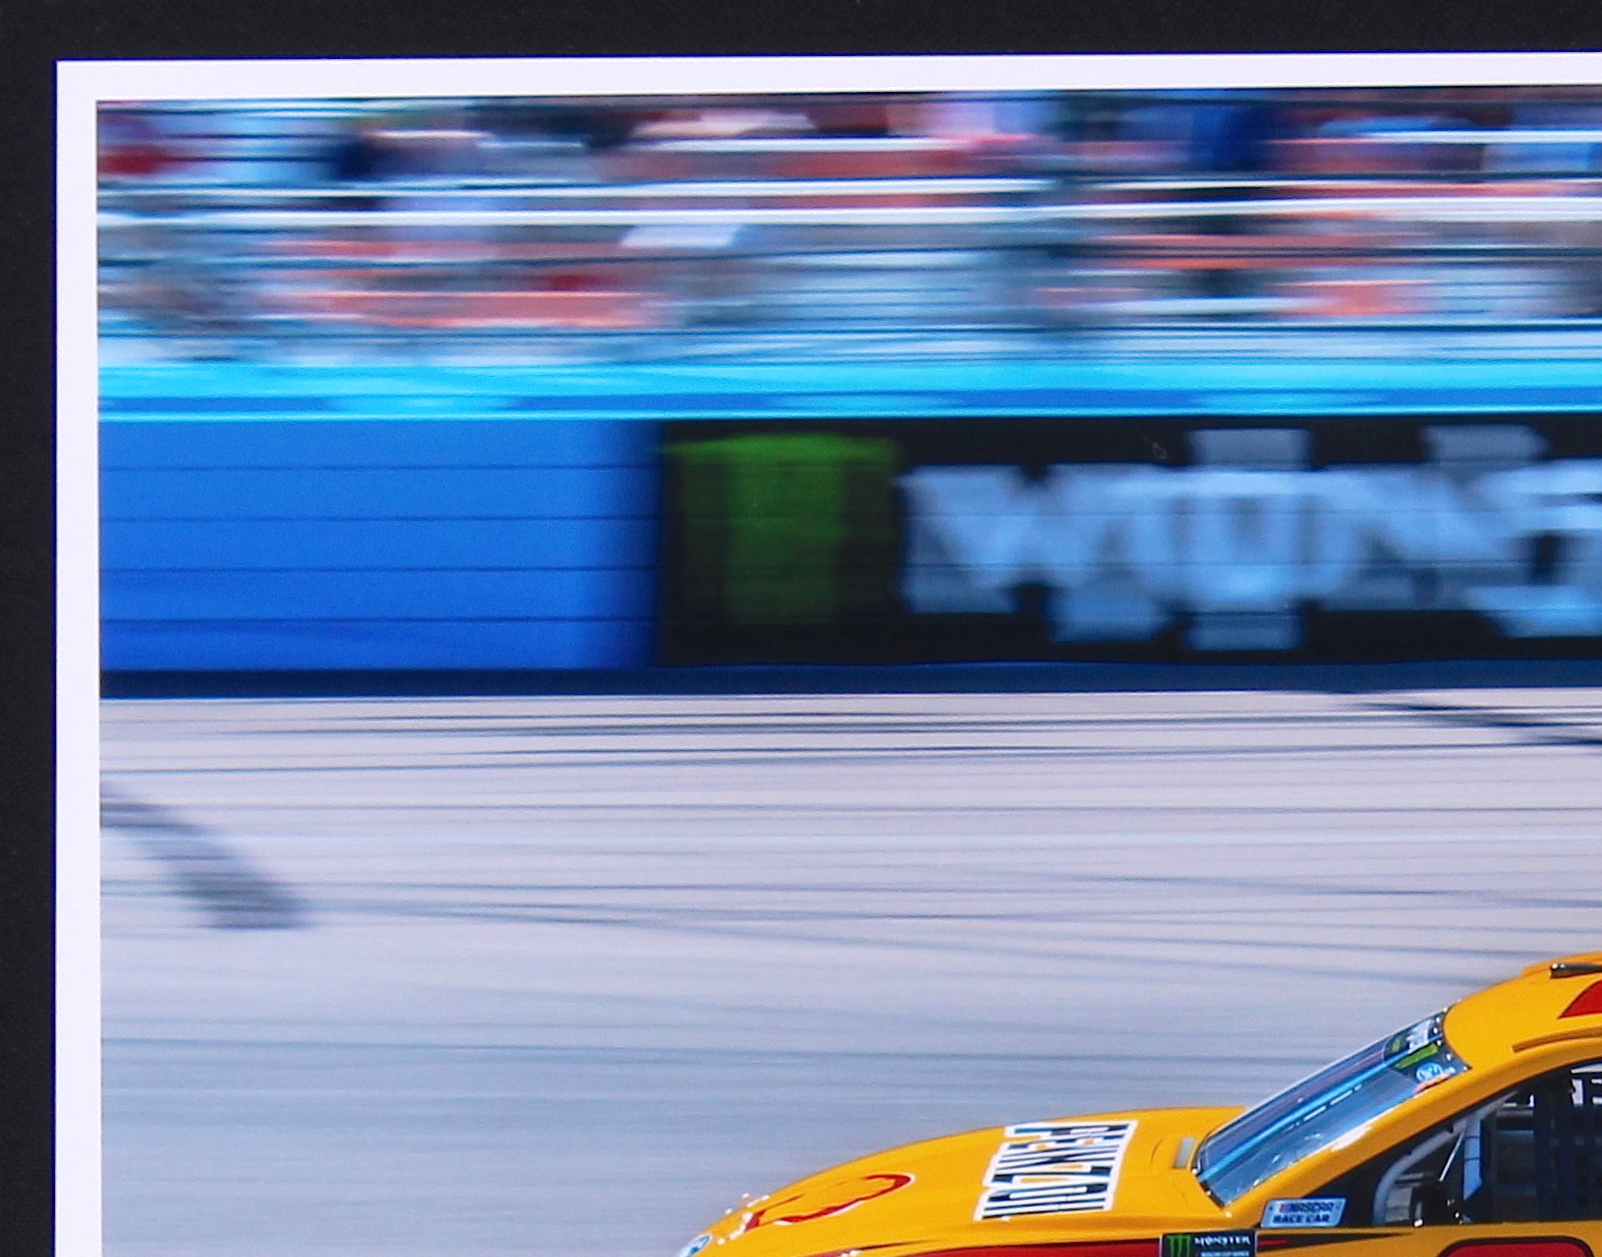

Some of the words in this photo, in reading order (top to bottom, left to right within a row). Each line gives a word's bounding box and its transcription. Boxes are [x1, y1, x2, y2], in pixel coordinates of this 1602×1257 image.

[1273, 1214, 1302, 1224] RACE
[1306, 1213, 1330, 1223] CAR
[1194, 1235, 1250, 1246] MONSTER
